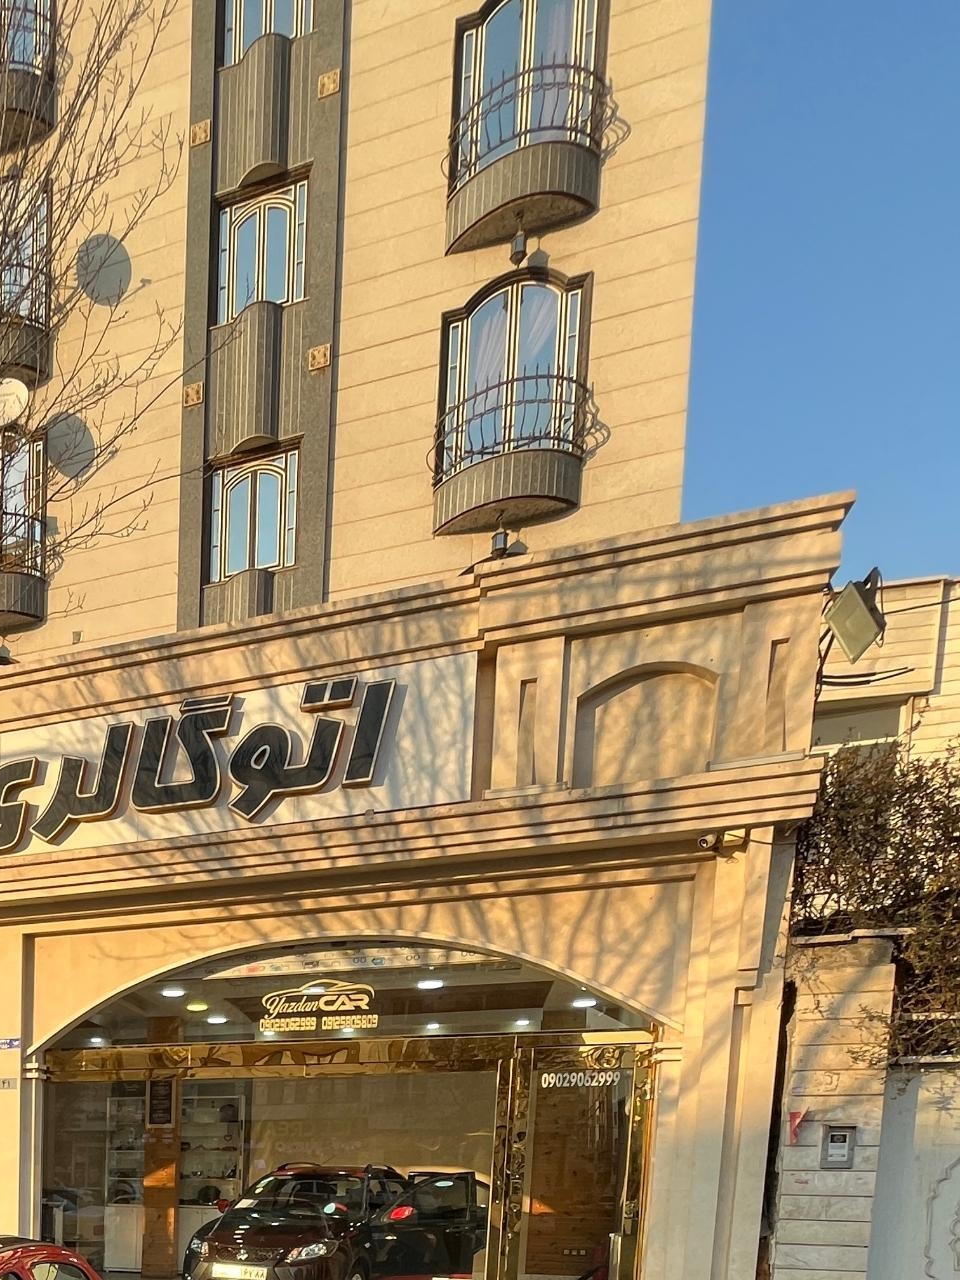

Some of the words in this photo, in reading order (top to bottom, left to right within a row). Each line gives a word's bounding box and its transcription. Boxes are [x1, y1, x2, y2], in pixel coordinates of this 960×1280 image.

[264, 995, 319, 1019] Yazdan
[319, 994, 370, 1011] CAR
[541, 1071, 620, 1088] 09029062999
